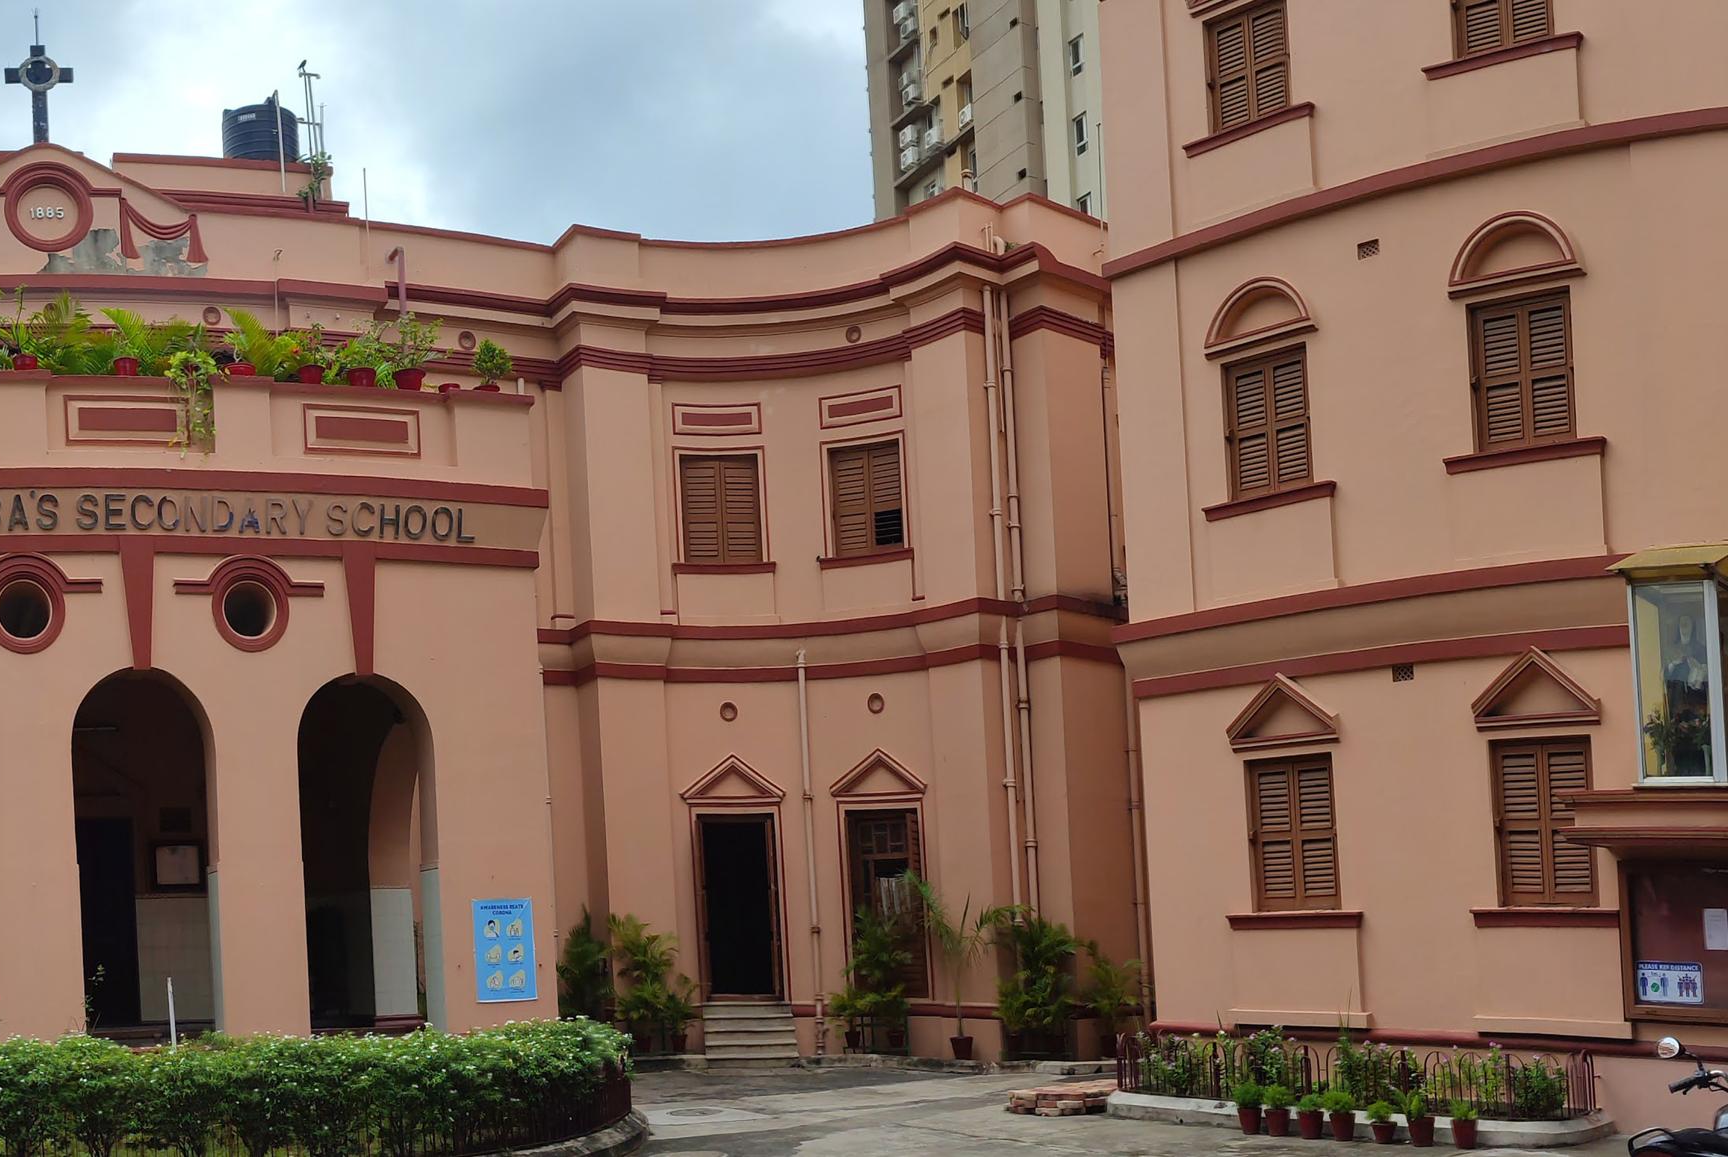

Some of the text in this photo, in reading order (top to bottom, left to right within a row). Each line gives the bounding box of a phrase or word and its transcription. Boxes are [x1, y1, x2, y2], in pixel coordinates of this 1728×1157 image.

[30, 207, 65, 220] 1885
[76, 493, 315, 535] SECONDARY
[326, 501, 476, 544] SCHOOL
